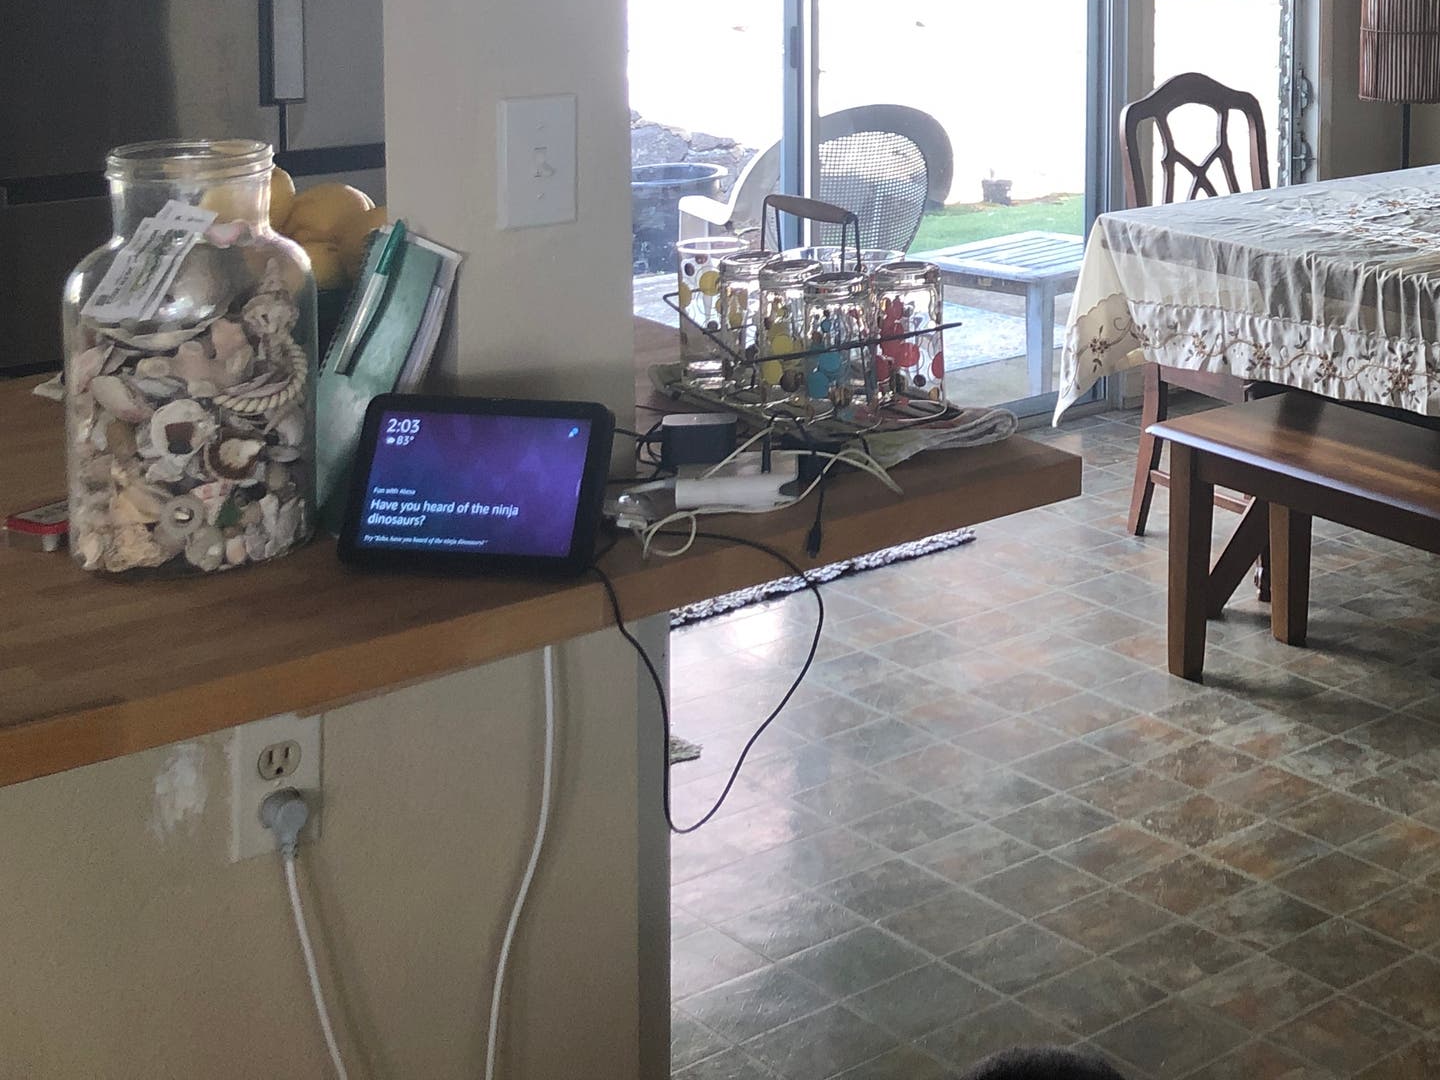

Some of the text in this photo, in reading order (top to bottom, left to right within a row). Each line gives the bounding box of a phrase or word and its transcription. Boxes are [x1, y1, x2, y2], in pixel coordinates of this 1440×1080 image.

[387, 418, 421, 433] 2:03
[396, 435, 415, 446] 83°
[373, 486, 385, 494] Fun
[371, 499, 519, 519] Have you heard of the ninja
[368, 513, 426, 526] dinosaurs?
